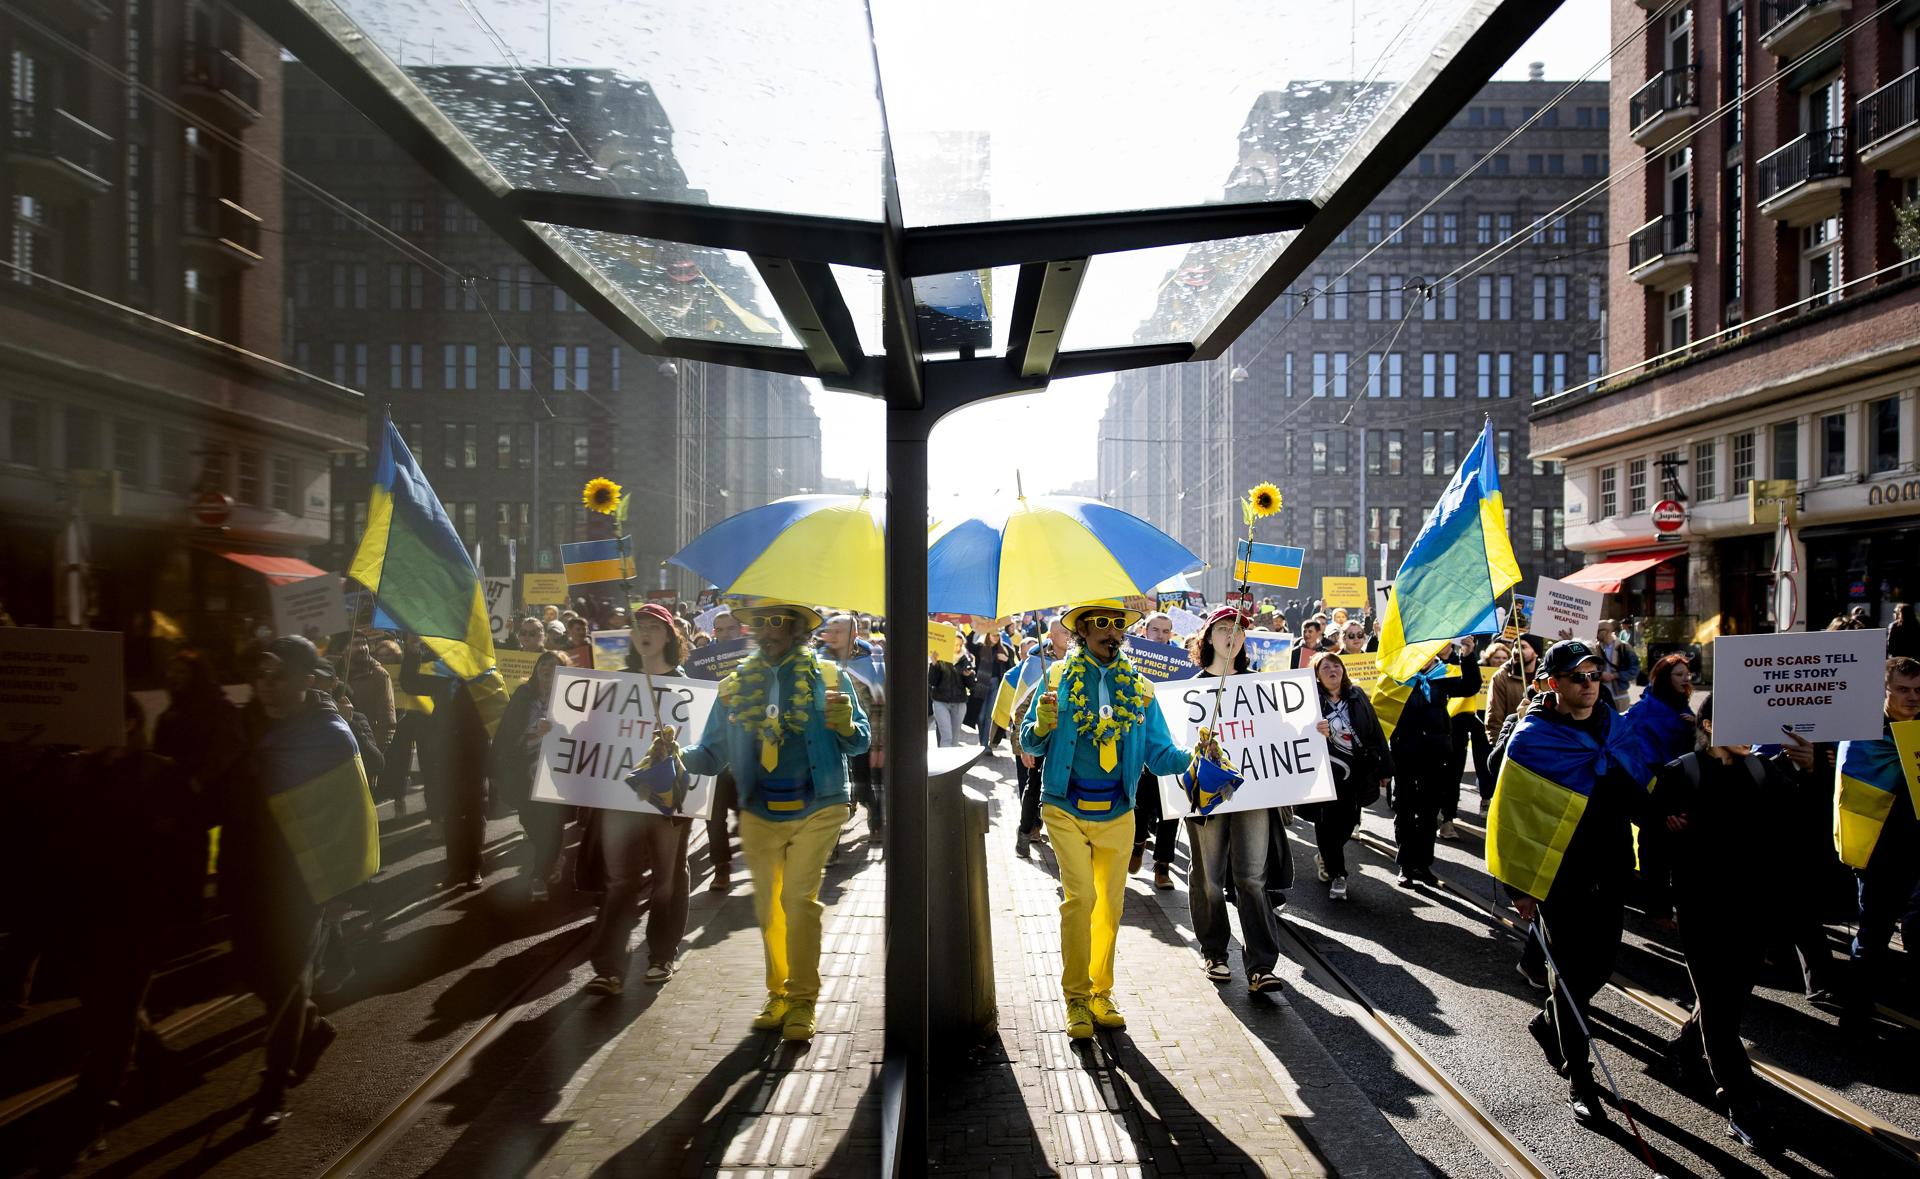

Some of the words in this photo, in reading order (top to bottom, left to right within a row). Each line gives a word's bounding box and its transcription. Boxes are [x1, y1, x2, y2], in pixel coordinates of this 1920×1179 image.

[1549, 591, 1574, 602] FREEDOM
[1547, 605, 1570, 615] UKRAINE
[1572, 612, 1588, 620] NEEDS
[1554, 615, 1579, 625] WEAPONS
[1135, 649, 1169, 662] WOUNDS
[1170, 657, 1193, 668] SHOW
[1144, 660, 1167, 670] PRICE
[1744, 658, 1772, 667] OUR
[1777, 655, 1821, 666] SCARS
[1825, 654, 1858, 663] TELL
[1763, 671, 1790, 680] THE
[1794, 668, 1838, 678] STORY
[1753, 685, 1770, 694] OF
[1775, 681, 1847, 693] UKRAINE'S
[1183, 681, 1304, 723] STAND
[1768, 696, 1832, 707] COURAGE
[1196, 720, 1254, 742] ITH
